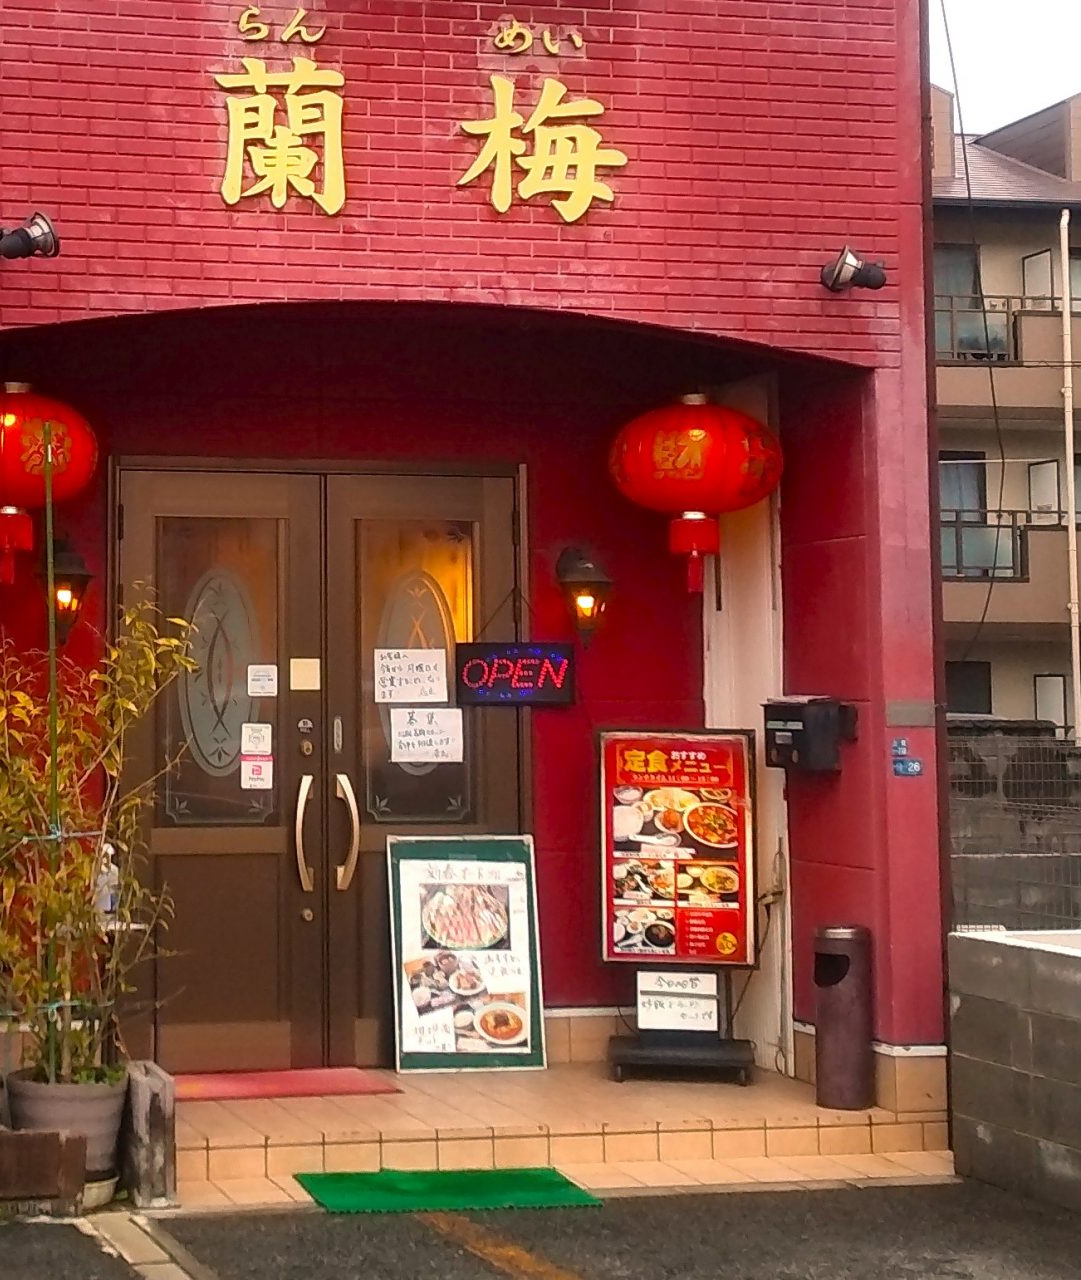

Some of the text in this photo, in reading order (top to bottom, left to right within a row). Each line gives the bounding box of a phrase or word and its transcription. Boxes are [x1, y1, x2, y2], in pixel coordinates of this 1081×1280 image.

[238, 5, 584, 55] らん めい
[461, 658, 569, 689] OPEN
[624, 749, 669, 773] 定食
[670, 760, 726, 773] メニュー
